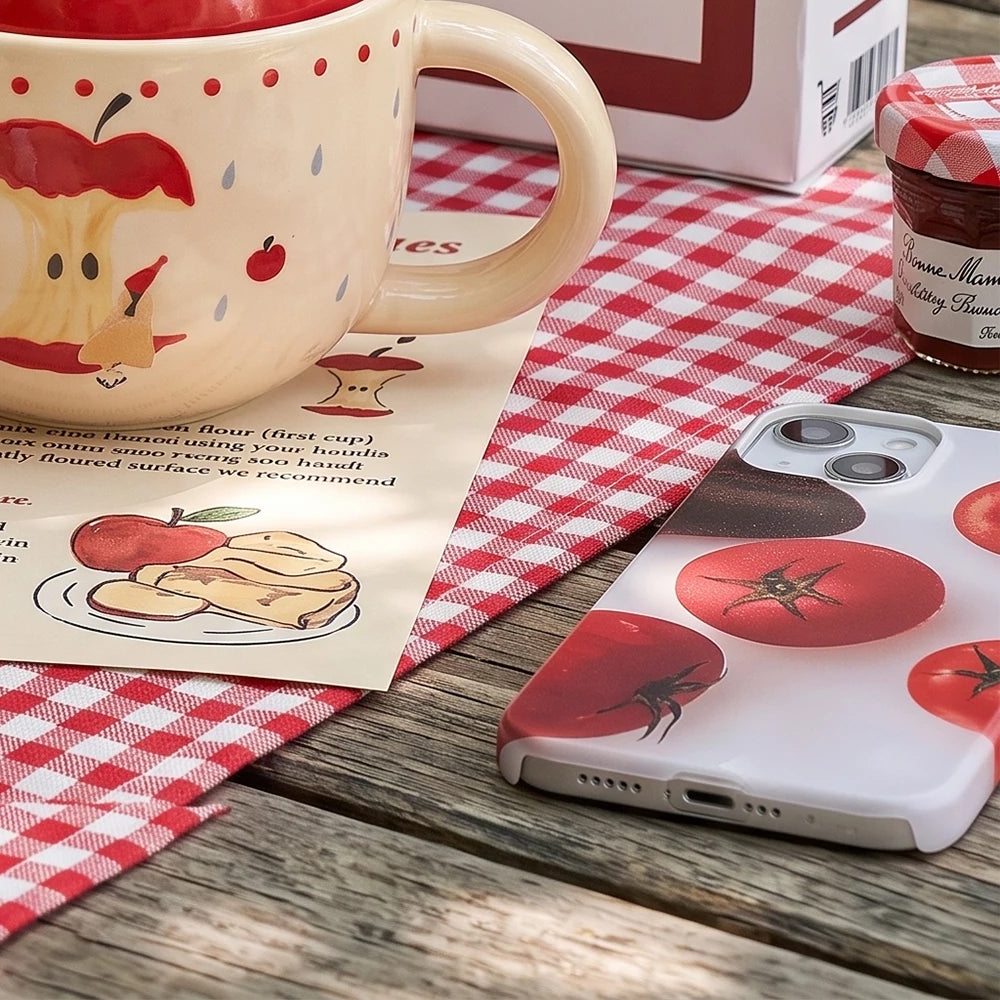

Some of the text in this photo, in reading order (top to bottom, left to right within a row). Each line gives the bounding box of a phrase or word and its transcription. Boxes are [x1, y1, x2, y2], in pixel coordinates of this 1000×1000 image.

[184, 438, 246, 453] using
[250, 443, 305, 454] your
[198, 424, 255, 437] flour
[261, 428, 317, 441] (first
[323, 434, 373, 446] cup)
[38, 453, 122, 469] floured
[127, 461, 211, 475] surface
[218, 468, 249, 478] we
[256, 470, 397, 487] recommend
